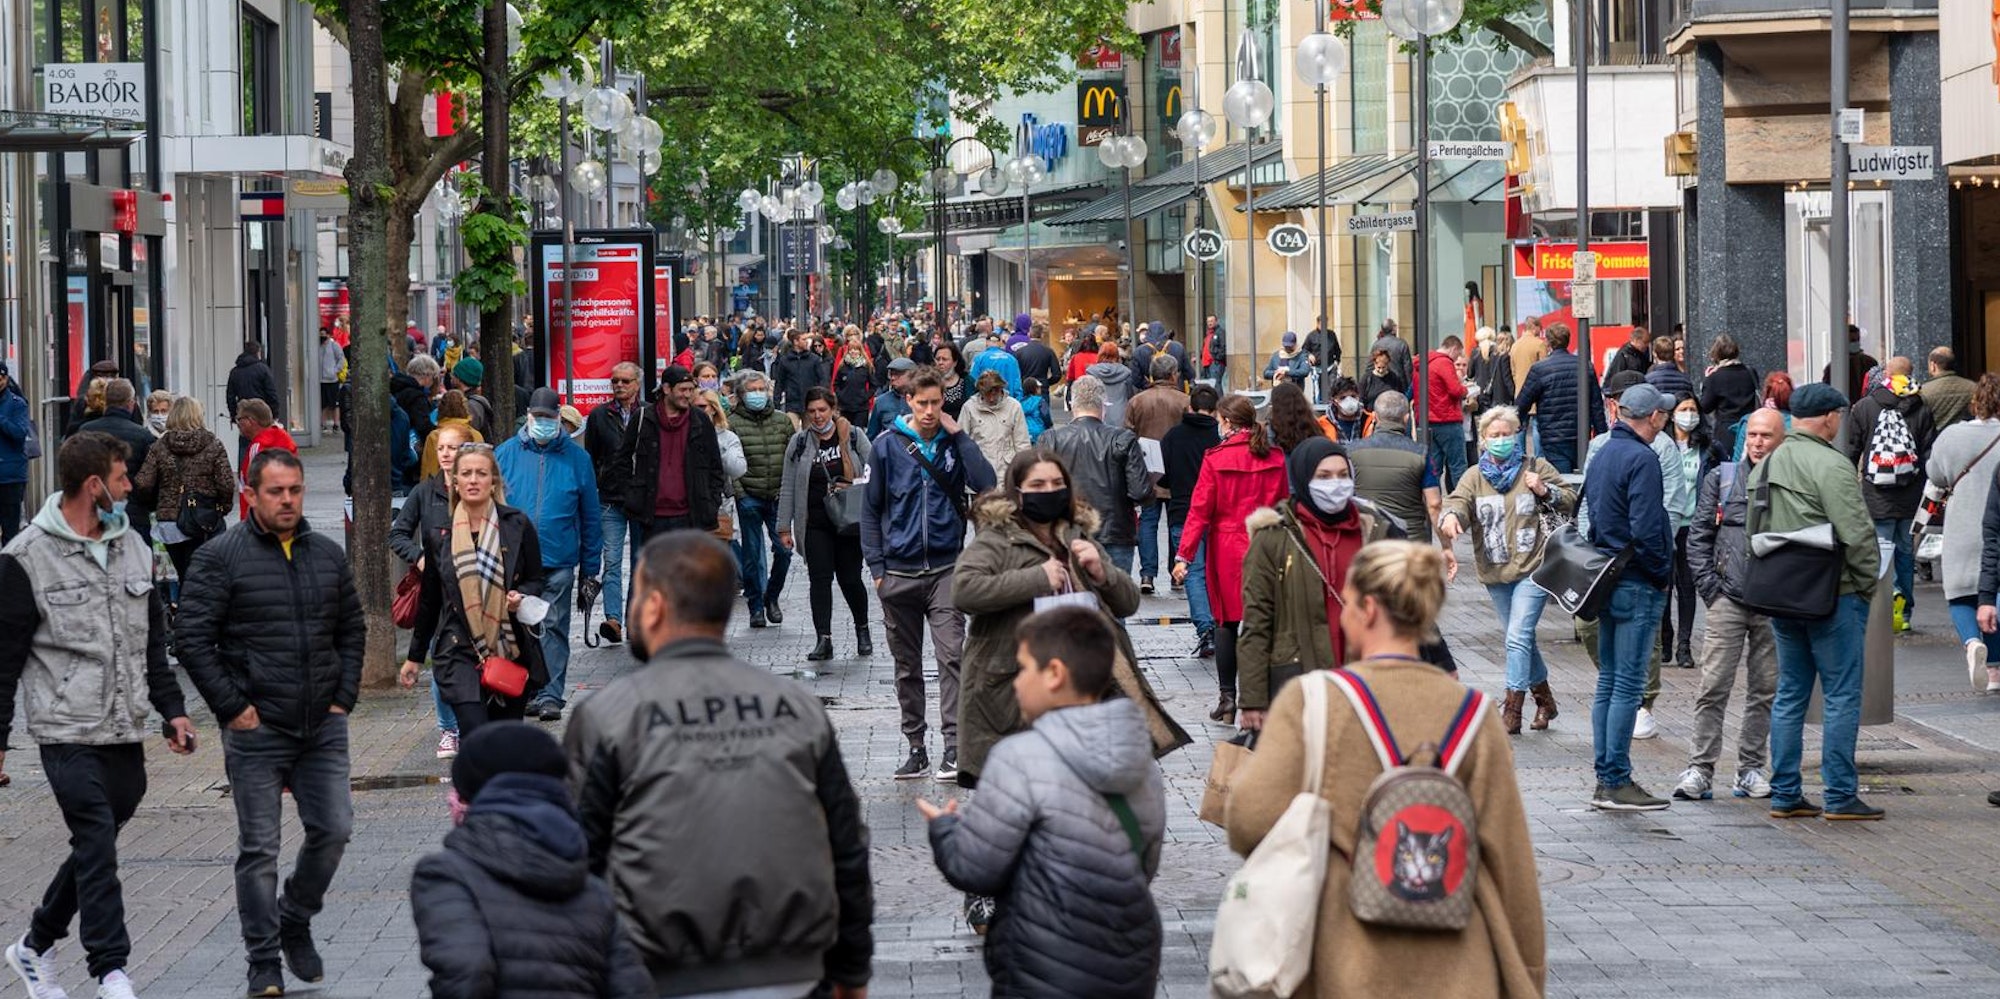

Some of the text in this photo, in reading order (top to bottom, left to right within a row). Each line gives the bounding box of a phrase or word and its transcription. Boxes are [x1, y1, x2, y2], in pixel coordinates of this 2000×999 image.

[49, 81, 140, 104] BABOR
[112, 108, 140, 118] SPA
[1439, 144, 1504, 159] Perlengäßchen
[1848, 151, 1933, 176] Ludwigstr.
[1348, 214, 1414, 231] Schildergasse
[1275, 232, 1304, 248] C&A
[552, 270, 595, 280] COID-19
[552, 298, 632, 308] Pflgefachpersonen
[646, 694, 801, 733] ALPHA
